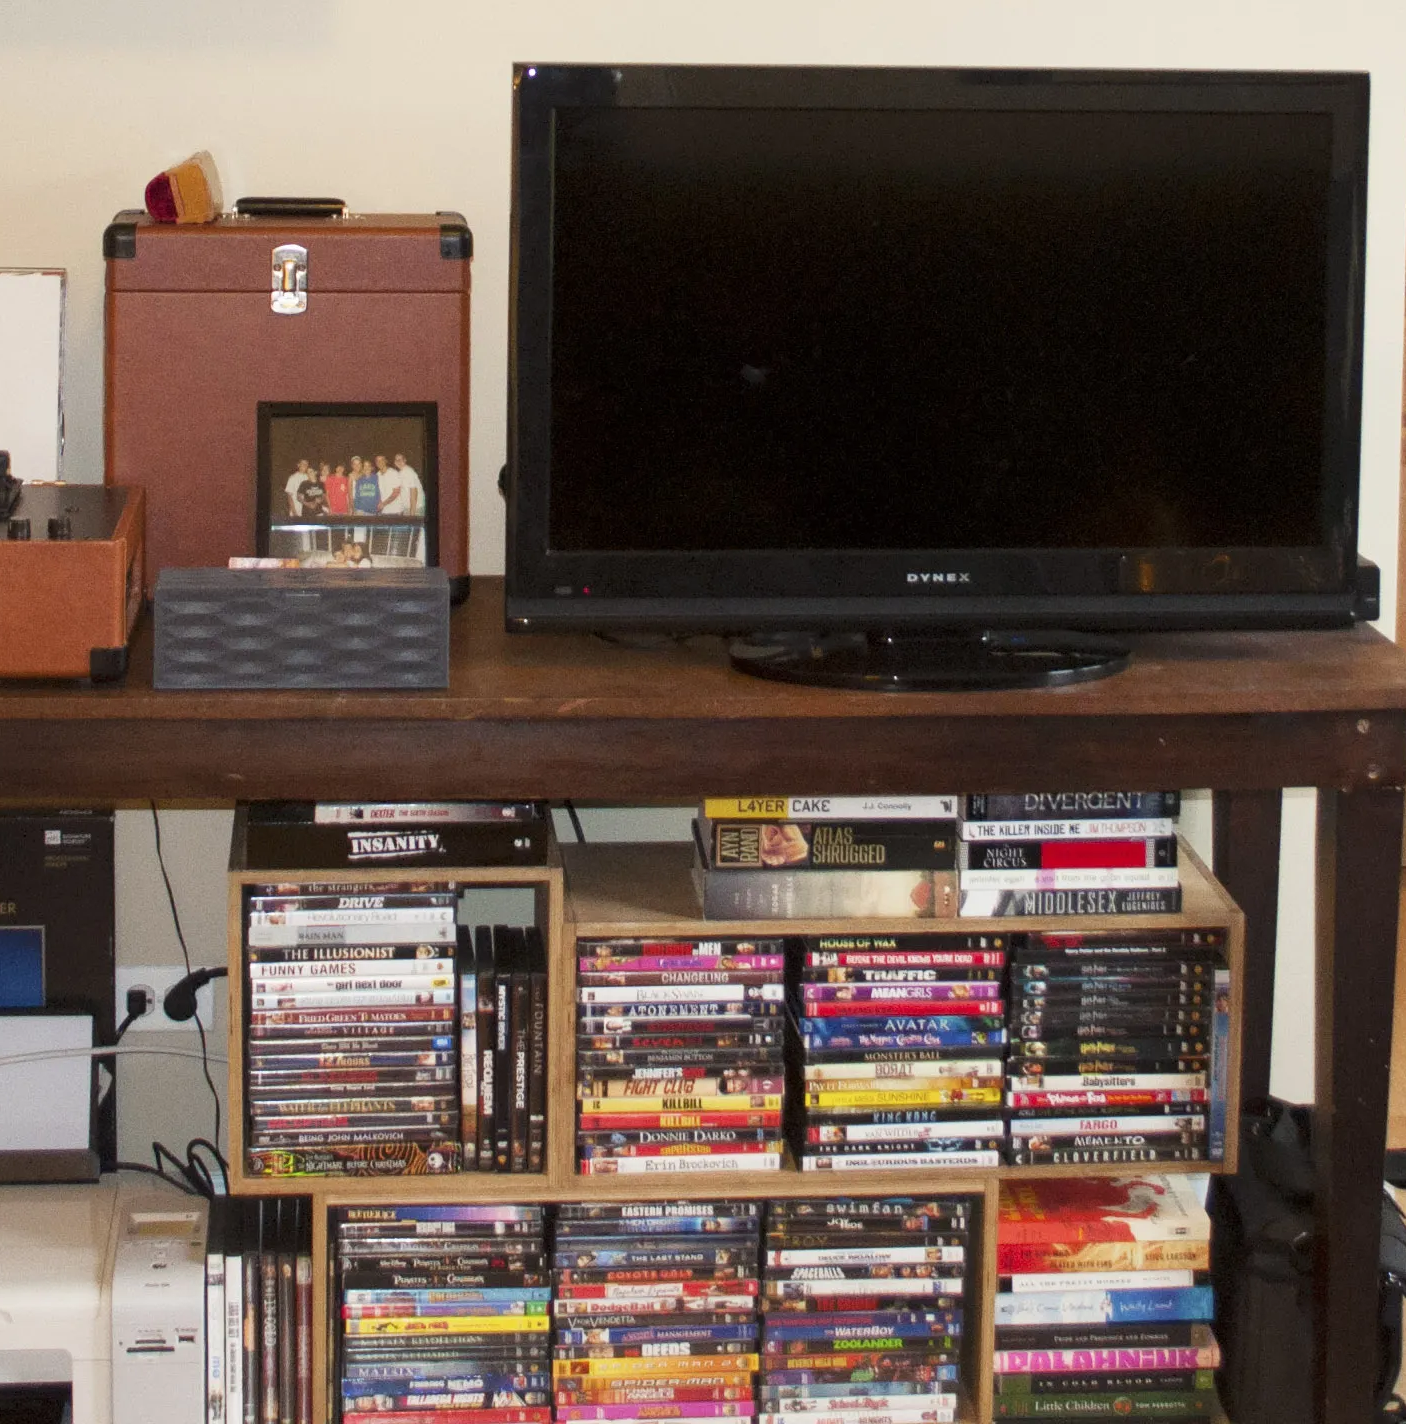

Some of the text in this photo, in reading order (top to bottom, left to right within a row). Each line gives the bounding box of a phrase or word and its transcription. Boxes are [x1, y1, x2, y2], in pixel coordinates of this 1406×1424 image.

[907, 573, 970, 582] DYNEX
[1025, 793, 1143, 810] DIVERGENT
[370, 809, 395, 818] DEXTER
[978, 824, 996, 835] THE
[999, 824, 1031, 835] KILLER
[1034, 824, 1066, 835] INSIDE
[1069, 823, 1081, 834] ME
[814, 827, 853, 845] ATLAS
[352, 834, 440, 854] INSANITY
[721, 832, 739, 863] AYN
[740, 828, 758, 863] RAND
[813, 844, 885, 864] SHRUGGED
[986, 848, 1024, 858] NIGHT
[984, 857, 1027, 868] CIRCUS
[309, 882, 373, 893] the strangers
[1127, 891, 1160, 901] JEFFREY
[338, 897, 384, 909] DRIVE
[1024, 890, 1117, 914] MIDDLESEX
[1121, 901, 1166, 911] EUGENIDES
[298, 931, 344, 941] RAIN MAN
[699, 942, 721, 955] MEN
[820, 939, 896, 948] HOUSE OF WAX
[283, 947, 395, 960] THE ILLUSIONIST
[872, 955, 885, 963] THE
[886, 955, 906, 963] DEVIL
[261, 963, 356, 976] FUNNY GAMES
[661, 973, 729, 984] CHANGELING
[863, 970, 936, 981] TRAFFIC
[380, 979, 402, 988] door
[628, 1004, 718, 1017] ATONEMENT
[299, 1013, 357, 1023] FRIED GREEN
[884, 1019, 950, 1031] AVATAR
[535, 1003, 544, 1075] FOUNTAIN
[864, 1052, 940, 1061] MONSTER'S BALL
[483, 1049, 493, 1115] REQUIEM
[516, 1051, 525, 1109] PRESTIGE
[1082, 1076, 1136, 1087] Babysitters
[624, 1079, 695, 1095] FIGHT CLUB
[877, 1092, 930, 1103] SUNSHINE
[328, 1101, 396, 1112] ELEPHANTS
[873, 1111, 937, 1123] KING KONG
[1079, 1120, 1118, 1130] FARGO
[299, 1132, 404, 1143] BEING JOHN MALKOVICH
[639, 1130, 736, 1143] DONNIE DARKO
[1074, 1135, 1145, 1146] MEMENTO
[877, 1143, 915, 1151] KNIGHT
[920, 1156, 978, 1165] BASTERDS
[1053, 1149, 1157, 1163] CLOVERFIELD
[645, 1158, 739, 1170] Erin Brockovich
[621, 1205, 714, 1217] EASTERN PROMISES
[826, 1202, 903, 1214] swimfan
[784, 1236, 828, 1246] TROY
[1165, 1252, 1197, 1261] LARSSON
[1076, 1259, 1095, 1268] WITH
[607, 1269, 693, 1280] COYOTE UGLY
[790, 1267, 846, 1279] SPACEBALLS
[590, 1302, 655, 1313] DodgeBall
[568, 1316, 636, 1330] V VENDETTA
[657, 1330, 712, 1339] MANAGEMENT
[835, 1326, 895, 1337] WATERBOY
[833, 1338, 903, 1349] ZOOLANDER
[1054, 1335, 1073, 1343] PRIDE
[641, 1342, 691, 1356] DEEDS
[1008, 1349, 1199, 1370] PALAHNIUK
[358, 1367, 414, 1377] MATRIX
[447, 1378, 483, 1388] NEMO
[611, 1376, 725, 1387] SPIDER-MAN
[1062, 1379, 1099, 1387] COLD
[1107, 1378, 1153, 1386] BLOOD
[1035, 1400, 1063, 1412] Little
[1065, 1400, 1110, 1411] Children
